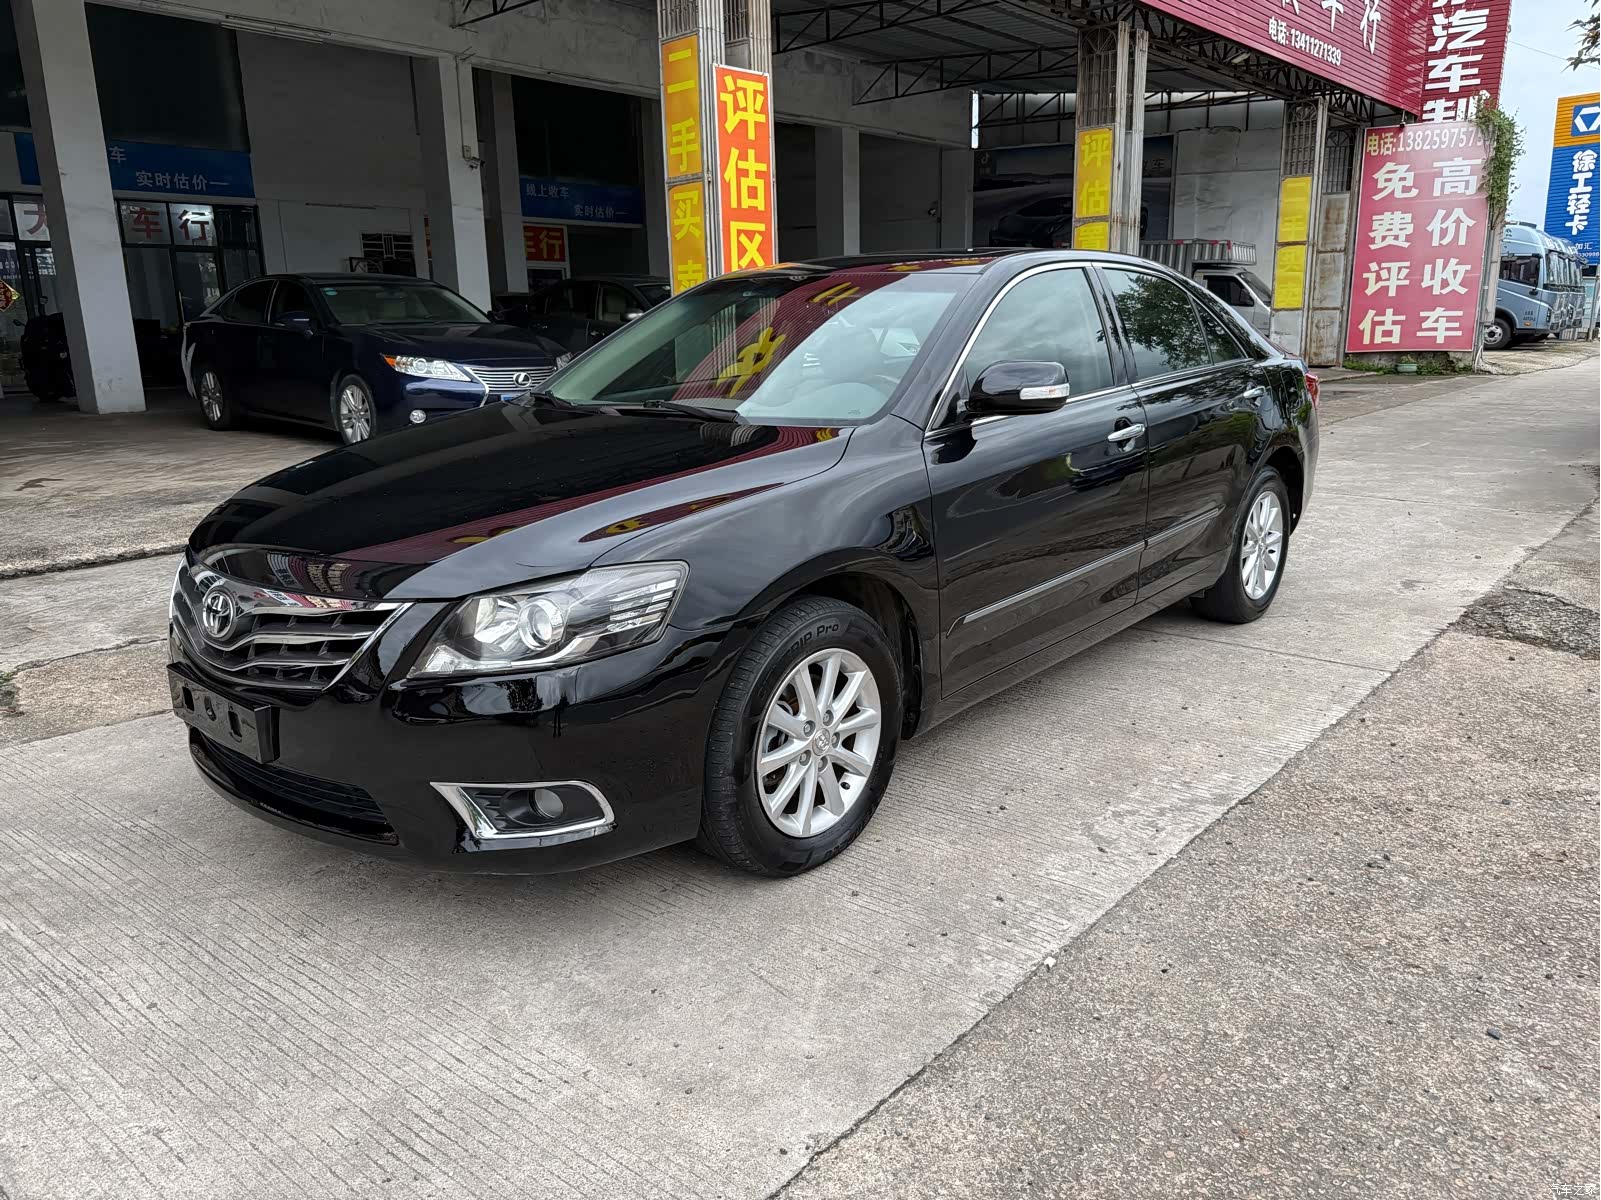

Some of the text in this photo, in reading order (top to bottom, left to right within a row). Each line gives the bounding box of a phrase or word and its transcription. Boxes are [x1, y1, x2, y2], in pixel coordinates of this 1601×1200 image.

[130, 207, 211, 241] 车行
[720, 75, 768, 272] 评估区
[1565, 149, 1598, 235] 徐工轻卡
[1358, 161, 1419, 345] 免费评估
[1416, 157, 1483, 344] 高价收车
[816, 623, 840, 638] Pro
